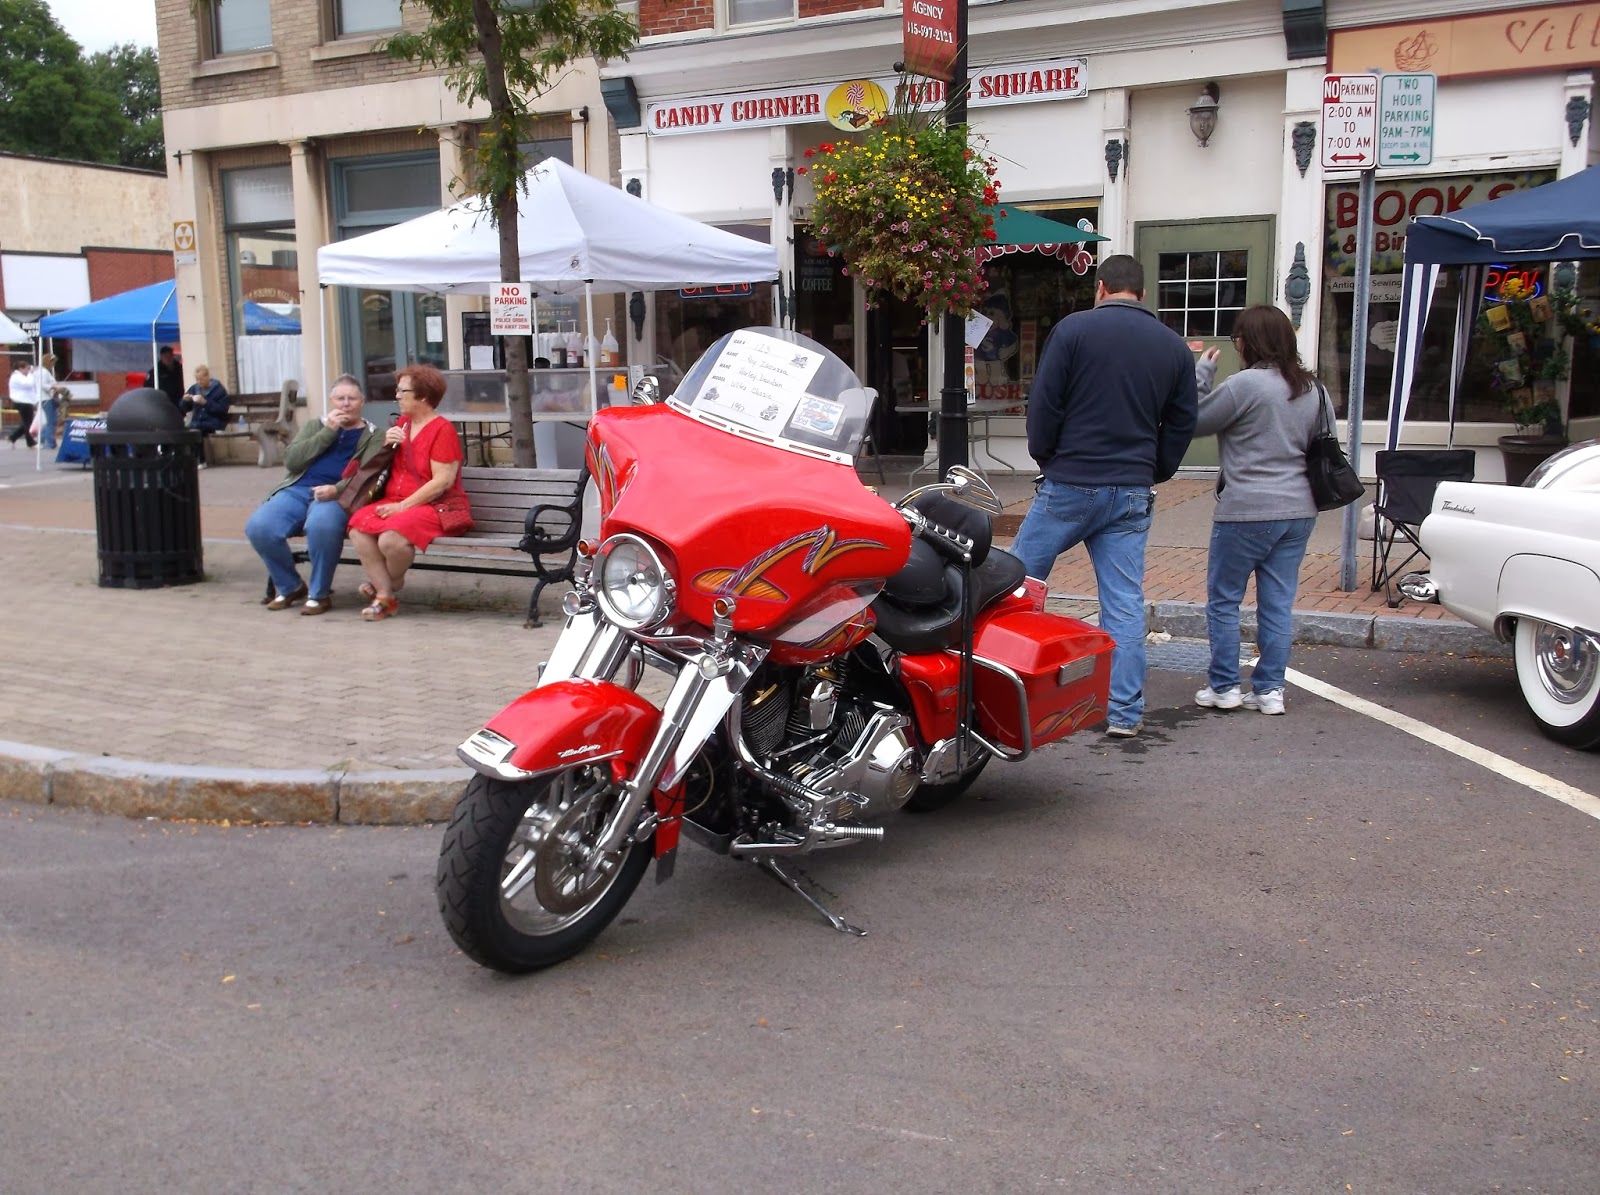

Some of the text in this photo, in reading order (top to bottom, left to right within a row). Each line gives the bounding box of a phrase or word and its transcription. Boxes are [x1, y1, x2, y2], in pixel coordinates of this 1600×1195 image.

[912, 0, 944, 20] AGENCY
[894, 66, 1079, 105] FUD SQUARE
[1324, 80, 1375, 99] NO PARKING
[1398, 78, 1419, 90] TWO
[1392, 94, 1422, 106] HOUR
[655, 93, 821, 129] CANDY CORNER
[1328, 106, 1372, 118] 2:00 AM
[1384, 110, 1429, 122] PARKING
[1343, 121, 1356, 133] TO
[1327, 137, 1371, 149] 7:00 AM
[802, 278, 832, 291] COFFEE
[1371, 279, 1402, 289] Sewing
[1485, 271, 1539, 294] PEN
[501, 287, 520, 296] NO
[1384, 293, 1402, 301] Sale
[494, 297, 528, 305] PARKING
